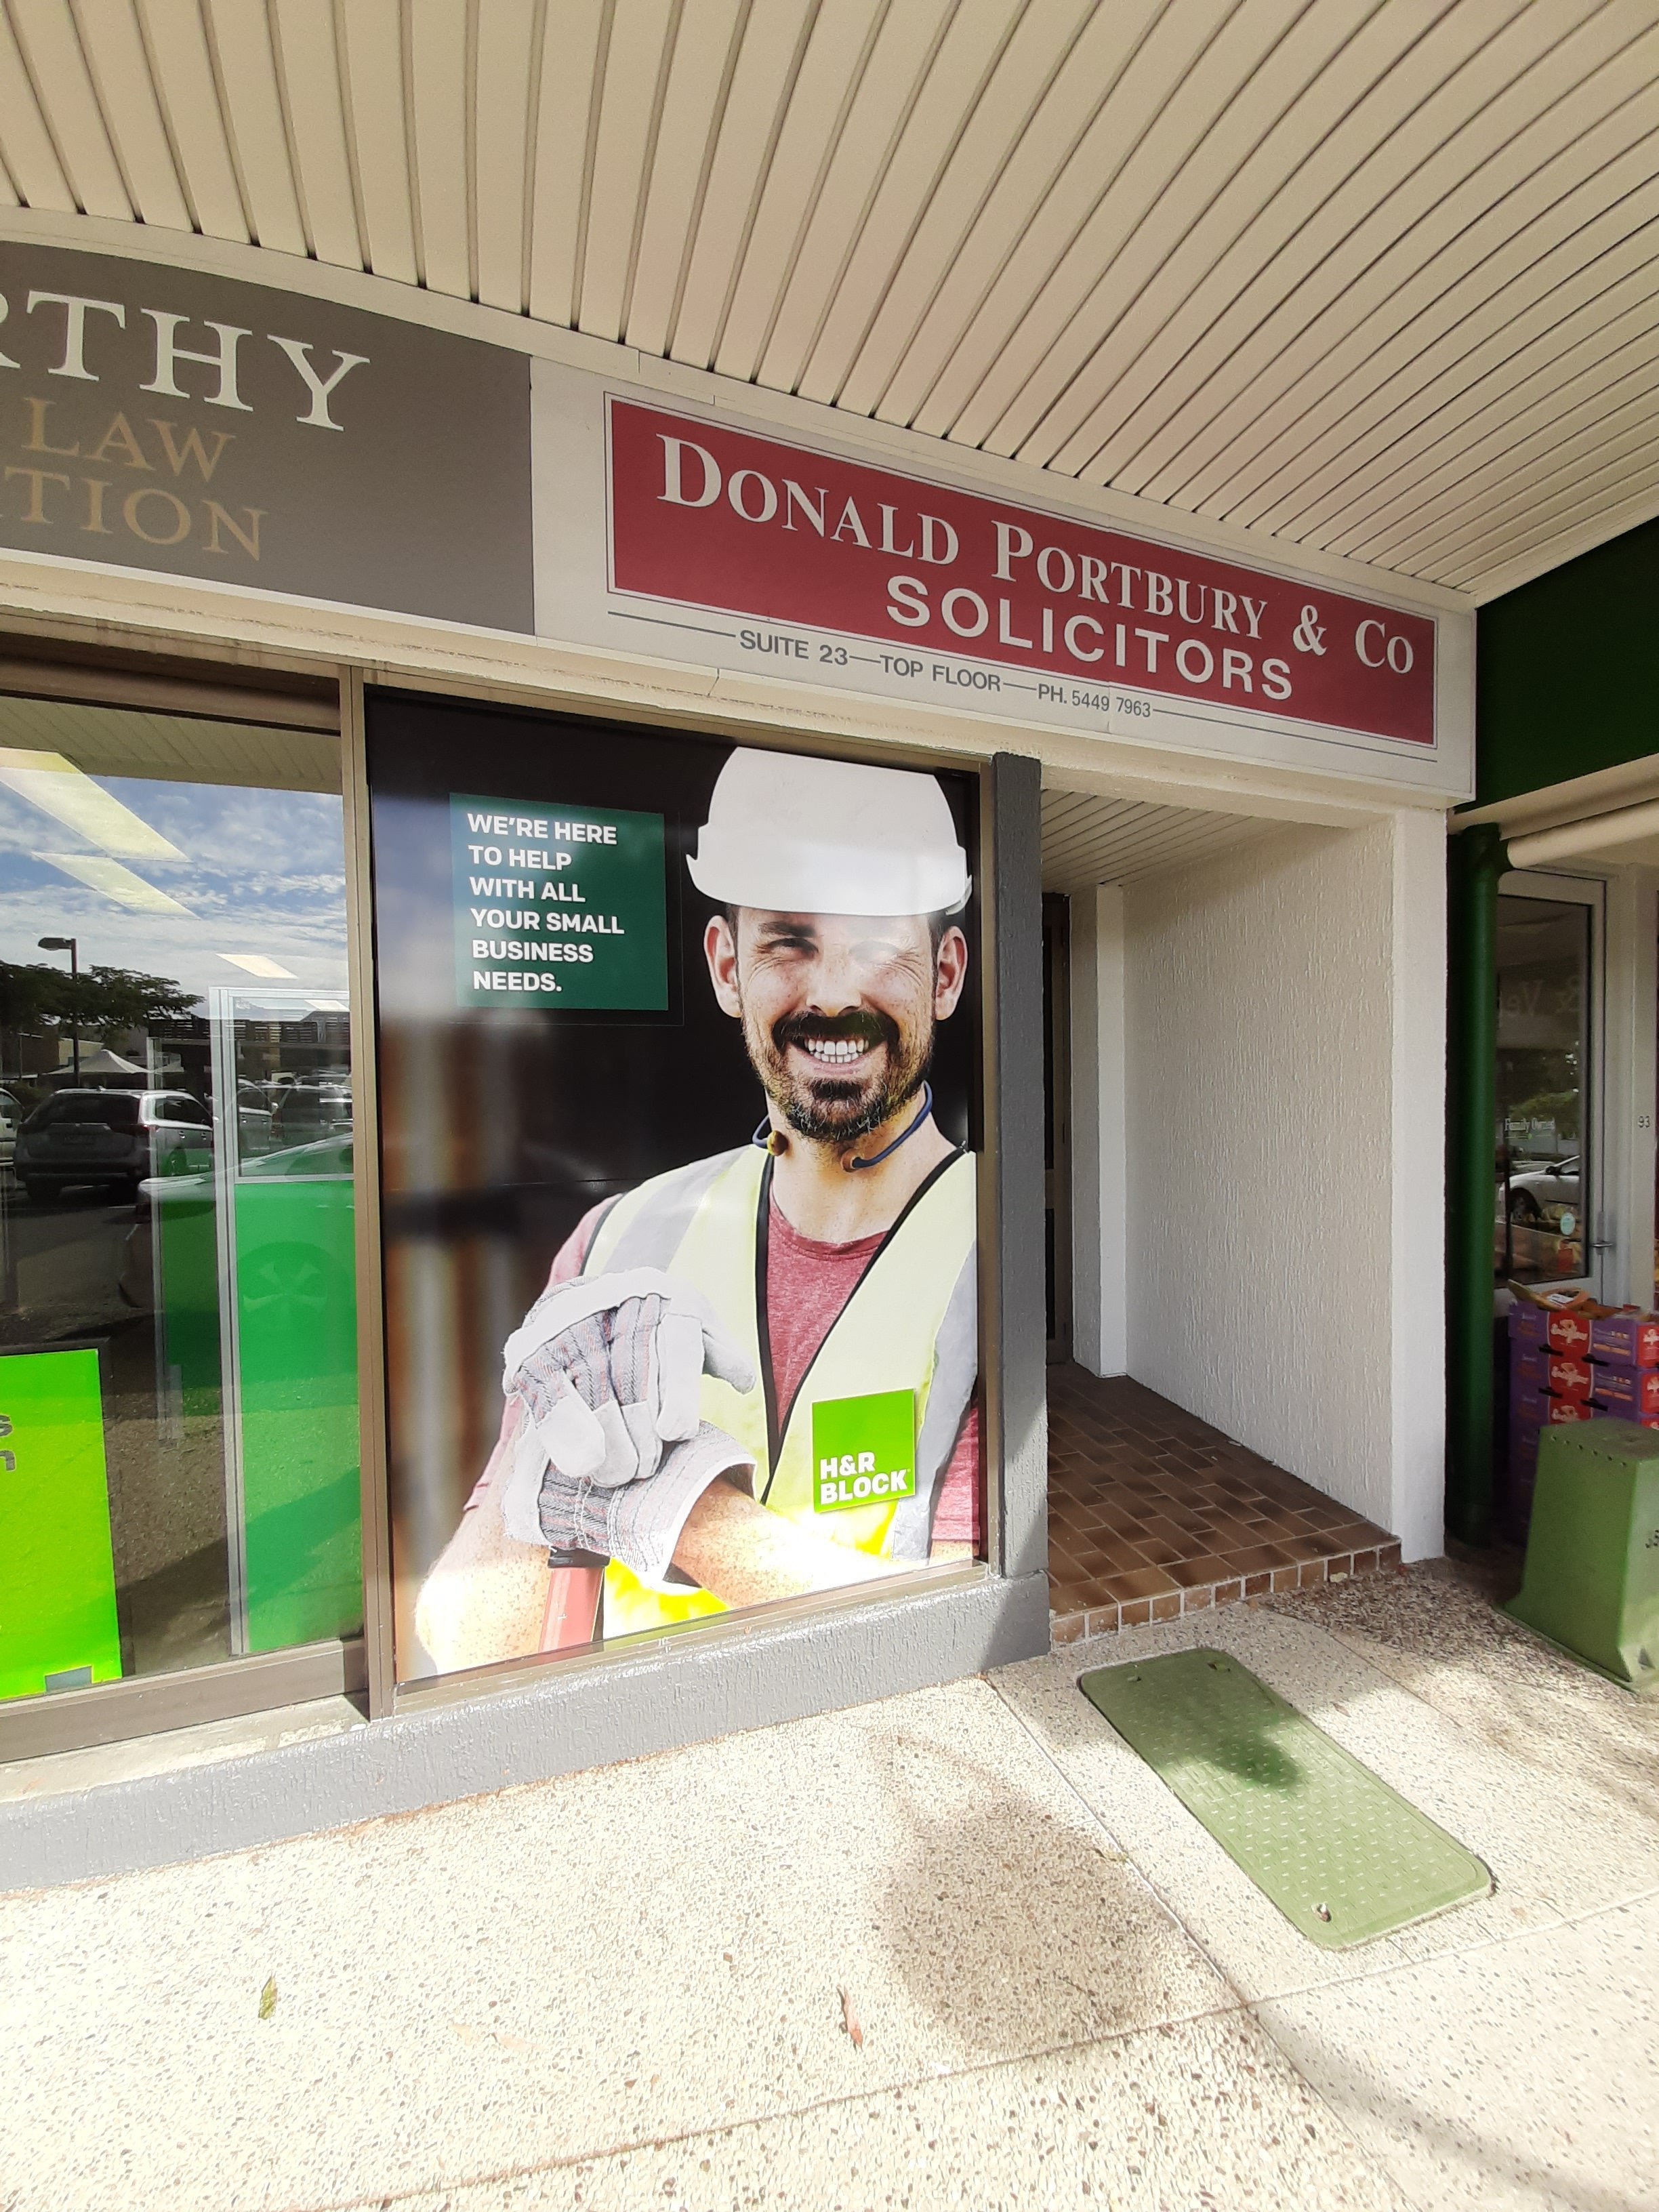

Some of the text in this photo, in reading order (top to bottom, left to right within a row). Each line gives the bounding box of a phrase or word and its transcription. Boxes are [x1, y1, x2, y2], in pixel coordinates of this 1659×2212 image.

[0, 289, 371, 432] THY
[21, 397, 236, 482] LAW
[0, 466, 268, 561] TION
[656, 433, 960, 566] DONALD
[990, 520, 1268, 640] PORTBURY
[1292, 605, 1328, 656] &
[886, 575, 1292, 701] SOLICITORS
[740, 630, 1151, 718] SUITE 23 TOP FLOOR PH. 5449 7963
[554, 821, 617, 845] HERE
[468, 845, 572, 871] TO HELP
[470, 876, 586, 903] WITH ALL
[470, 908, 625, 935] YOUR SMALL
[472, 939, 594, 963] BUSINESS
[474, 970, 562, 992] NEEDS.
[1638, 1115, 1650, 1128] 93
[820, 1451, 876, 1480] H&R
[820, 1469, 908, 1505] BLOCK
